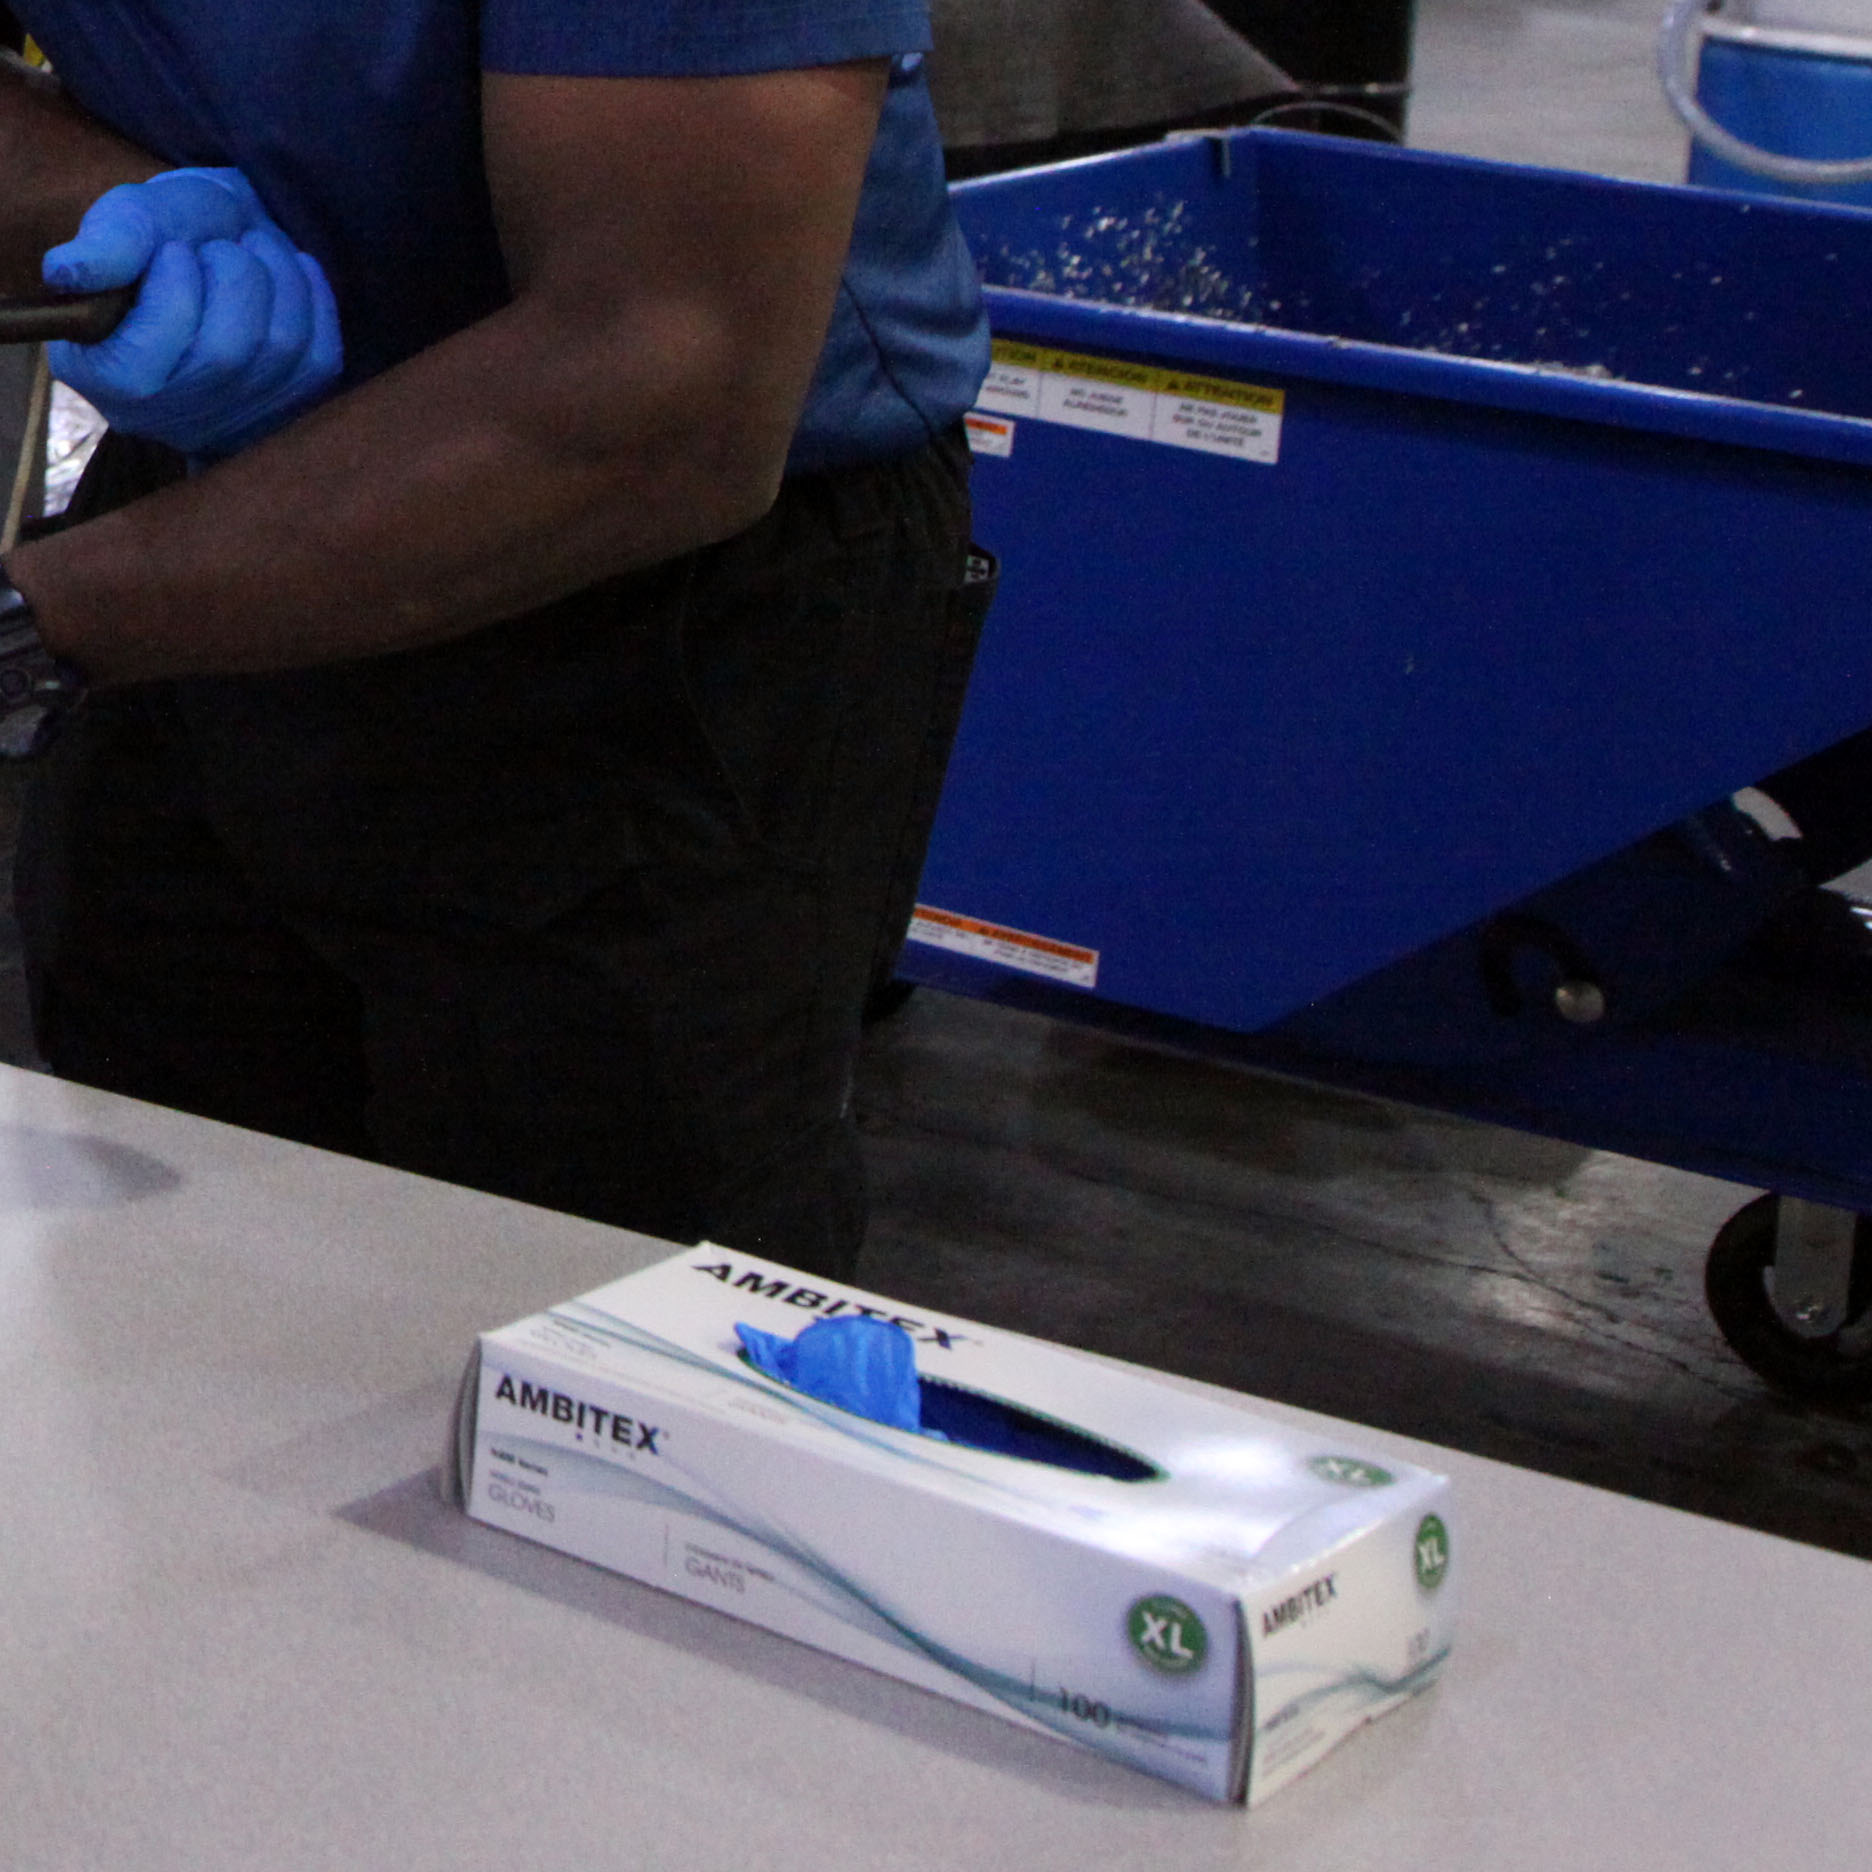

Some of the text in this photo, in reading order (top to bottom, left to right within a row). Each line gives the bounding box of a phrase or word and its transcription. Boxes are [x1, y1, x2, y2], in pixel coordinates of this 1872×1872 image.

[495, 1373, 660, 1457] AMBITEX
[487, 1482, 556, 1524] GLOVES
[684, 1555, 746, 1594] GANTS
[1417, 1536, 1447, 1574] XL
[1260, 1572, 1338, 1639] AMBITEX
[1139, 1610, 1195, 1661] XL
[1058, 1685, 1113, 1729] 100
